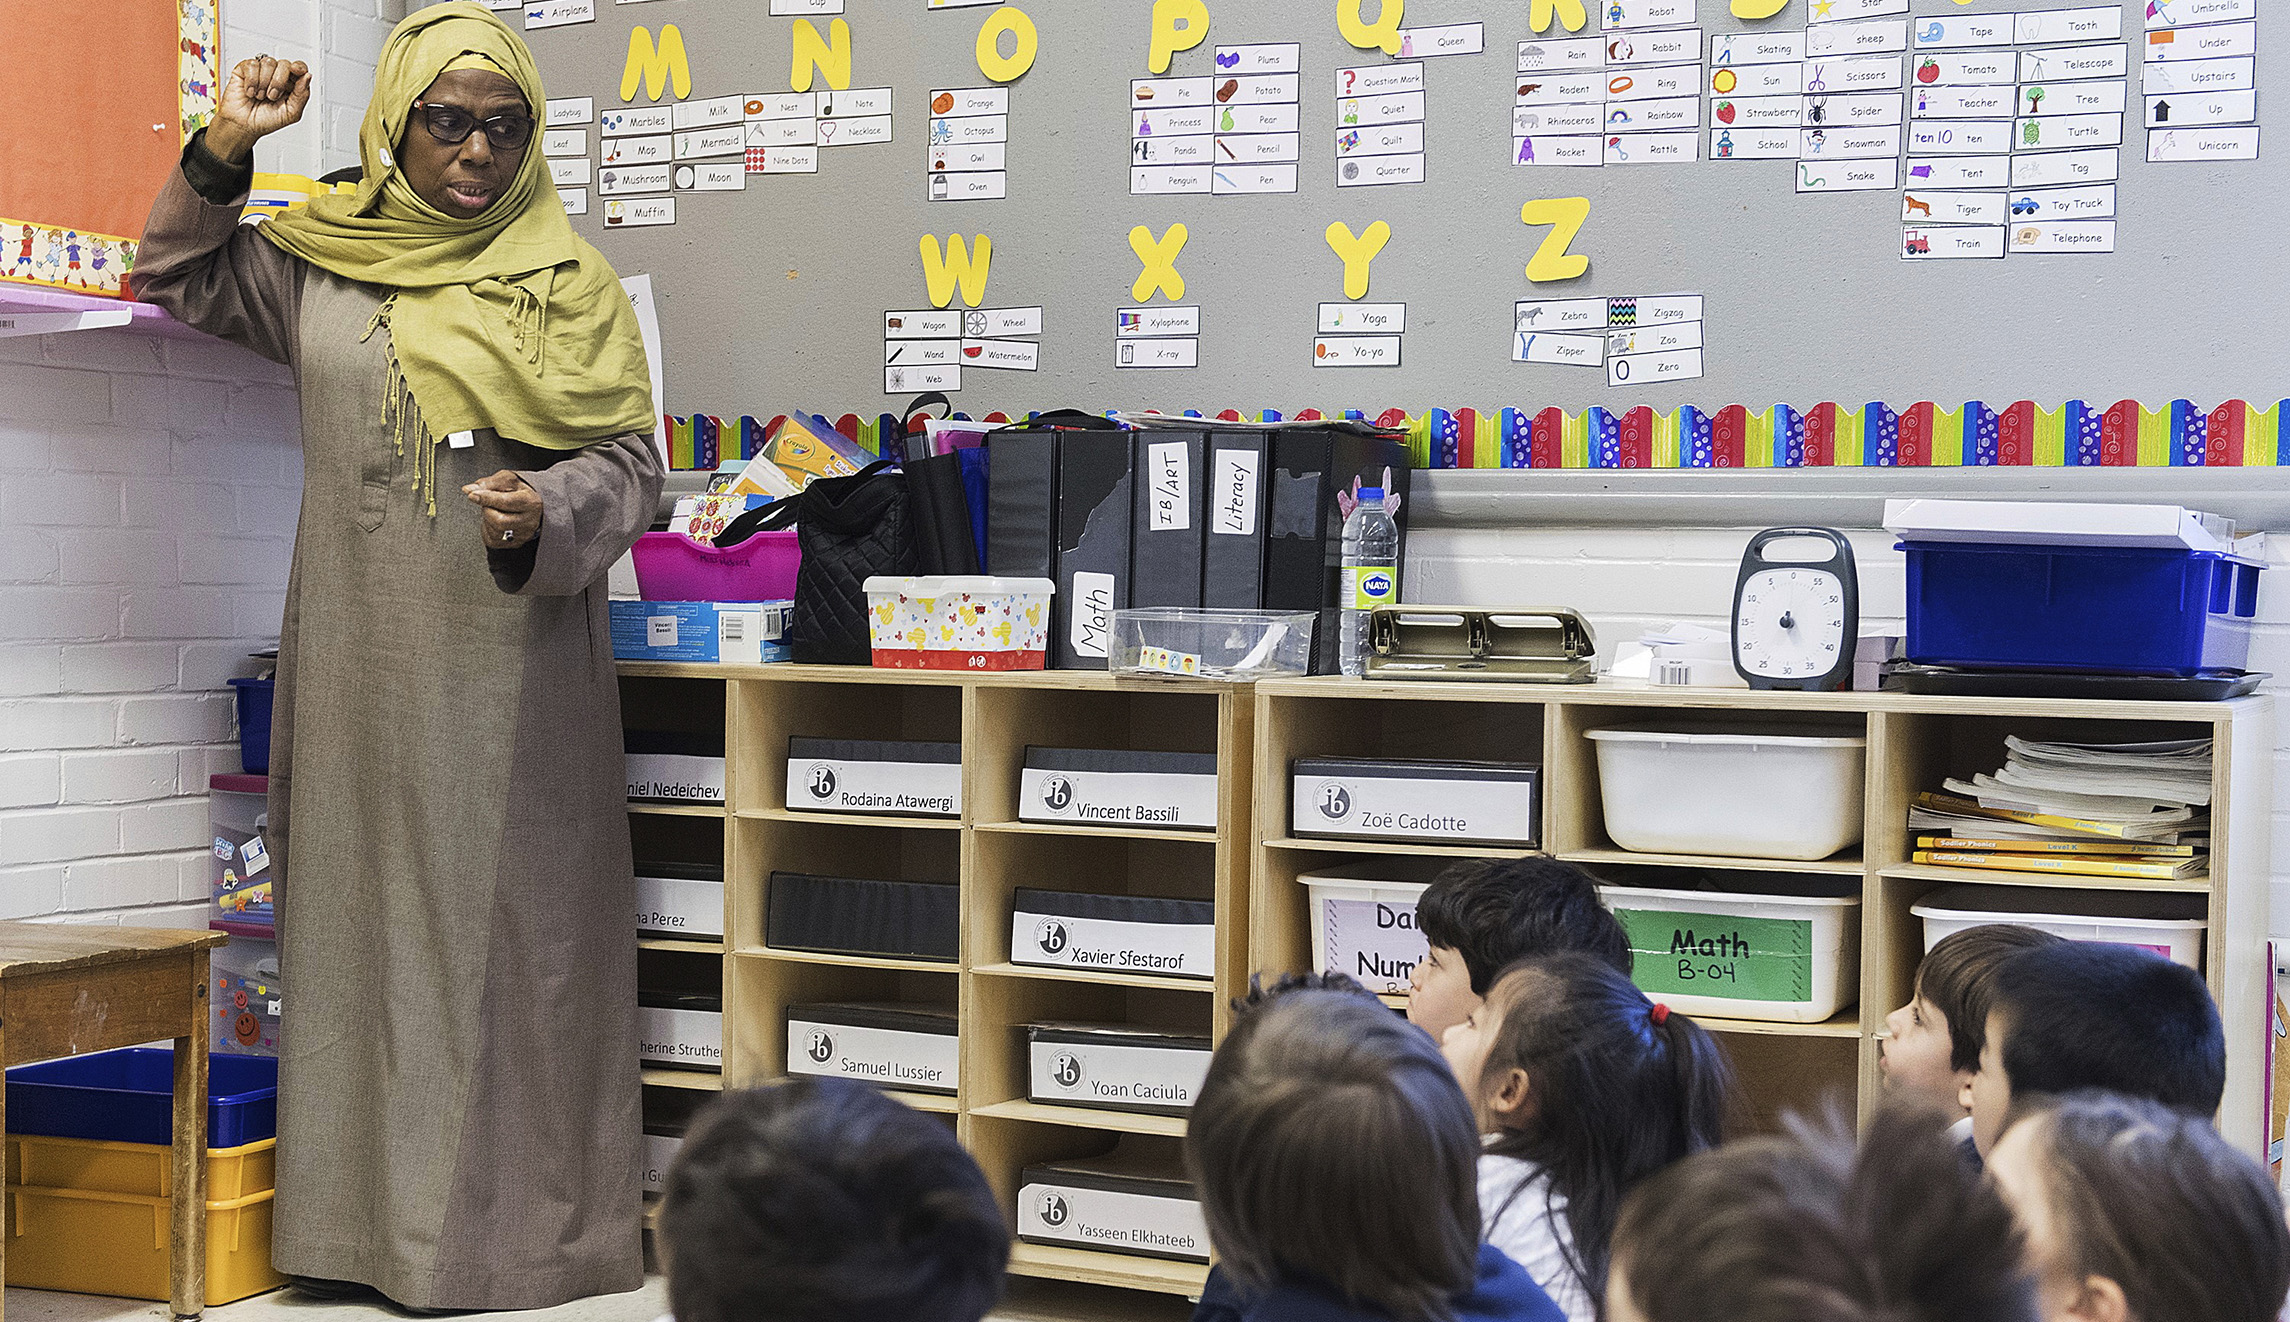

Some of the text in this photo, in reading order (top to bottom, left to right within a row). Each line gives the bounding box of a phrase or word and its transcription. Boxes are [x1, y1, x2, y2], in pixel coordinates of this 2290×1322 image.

[551, 4, 589, 19] Airplane
[1648, 7, 1675, 17] Robot
[2191, 0, 2239, 14] Umbrella
[1337, 0, 1404, 55] Q
[2068, 20, 2098, 31] Tooth
[1148, 0, 1209, 74] P
[1969, 27, 1993, 39] Tape
[976, 6, 1038, 82] O
[1437, 37, 1465, 48] Queen
[1856, 34, 1885, 45] sheep
[2199, 38, 2232, 49] Under
[1652, 42, 1682, 53] Rabbit
[1756, 45, 1792, 56] Skating
[790, 18, 851, 92] N
[1257, 55, 1280, 65] Plums
[1567, 50, 1587, 60] Rain
[620, 24, 691, 101] M
[2063, 59, 2114, 70] Telescope
[1961, 65, 1997, 75] Tomato
[1363, 74, 1420, 88] Question Mark
[1763, 76, 1781, 86] Sun
[1845, 71, 1886, 82] Scissors
[2191, 72, 2236, 85] Upstairs
[1559, 85, 1590, 95] Rodent
[1657, 79, 1677, 90] Ring
[1178, 88, 1190, 98] Pie
[1255, 86, 1282, 95] Potato
[855, 100, 874, 108] Note
[966, 99, 994, 110] Orange
[1958, 98, 1998, 108] Teacher
[2075, 94, 2100, 104] Tree
[708, 105, 729, 117] Milk
[780, 104, 798, 112] Nest
[1381, 105, 1405, 116] Quiet
[1746, 107, 1801, 119] Strawberry
[1850, 106, 1883, 118] Spider
[2208, 104, 2224, 116] Up
[553, 109, 582, 119] Ladybug
[1259, 115, 1278, 124] Pear
[1647, 110, 1684, 120] Rainbow
[629, 115, 666, 128] Marbles
[1168, 118, 1202, 127] Princess
[1547, 117, 1595, 126] Rhinoceros
[783, 129, 797, 138] Net
[848, 127, 882, 136] Necklace
[964, 127, 995, 136] Octopus
[1914, 129, 1953, 144] ten 10
[2067, 126, 2099, 137] Turtle
[553, 139, 569, 149] Leaf
[700, 135, 739, 149] Mermaid
[1381, 135, 1403, 147] Quilt
[1757, 139, 1788, 150] School
[1843, 139, 1886, 149] Snowman
[1966, 135, 1983, 144] ten
[637, 145, 657, 156] Mop
[1174, 146, 1197, 155] Panda
[1256, 144, 1280, 154] Pencil
[1650, 144, 1678, 154] Rattle
[2198, 140, 2239, 151] Unicorn
[1555, 147, 1586, 157] Rocket
[773, 156, 809, 165] Nine Dots
[970, 153, 985, 163] Owl
[558, 169, 573, 178] Lion
[1375, 166, 1411, 177] Quarter
[1960, 168, 1984, 178] Tent
[2070, 163, 2089, 175] Tag
[622, 174, 668, 185] Mushroom
[707, 172, 732, 183] Moon
[1168, 176, 1198, 187] Penguin
[1259, 175, 1274, 185] Pen
[1846, 171, 1875, 181] Snake
[968, 182, 988, 192] Oven
[1956, 204, 1982, 217] Tiger
[2051, 198, 2103, 212] Toy Truck
[634, 206, 666, 218] Muffin
[1521, 197, 1590, 282] Z
[1955, 239, 1981, 249] Train
[2052, 233, 2103, 245] Telephone
[1128, 223, 1188, 302] X
[1325, 220, 1391, 300] Y
[920, 233, 991, 308] W
[1361, 312, 1387, 327] Yoga
[1561, 311, 1588, 321] Zebra
[1654, 308, 1684, 320] Zigzag
[921, 321, 947, 332] Wagon
[1002, 318, 1026, 327] Wheel
[1149, 317, 1190, 329] Xylophone
[1660, 336, 1677, 345] Zoo
[923, 350, 945, 359] Wand
[987, 351, 1033, 362] Watermelon
[1156, 349, 1180, 361] X-ray
[1353, 346, 1384, 360] Yo-yo
[1556, 345, 1585, 357] Zipper
[1657, 363, 1680, 373] Zero
[925, 375, 943, 384] Web
[1160, 451, 1179, 525] IB/ART
[1226, 462, 1251, 531] Literacy
[1365, 581, 1389, 590] NAYA
[1768, 578, 1774, 586] 5
[1813, 578, 1823, 586] 55
[1829, 595, 1839, 603] 50
[1081, 588, 1110, 653] Math
[1741, 618, 1749, 626] 15
[1743, 642, 1752, 650] 20
[1825, 643, 1834, 651] 40
[1759, 660, 1768, 668] 25
[1805, 662, 1814, 670] 35
[1783, 667, 1792, 675] 30
[653, 782, 719, 798] Nedeichev
[842, 792, 952, 811] Rodaina Atawergi
[1077, 803, 1178, 821] Vincent Bassili
[1362, 812, 1466, 831] Zoë Cadotte
[652, 912, 684, 926] Perez
[1670, 929, 1749, 960] Math
[1072, 948, 1184, 969] Xavier Sfestarof
[1678, 960, 1736, 983] B-04
[842, 1058, 942, 1081] Samuel Lussier
[1092, 1081, 1186, 1100] Yoan Caciula
[1078, 1224, 1194, 1248] Yasseen Elkhateeb
